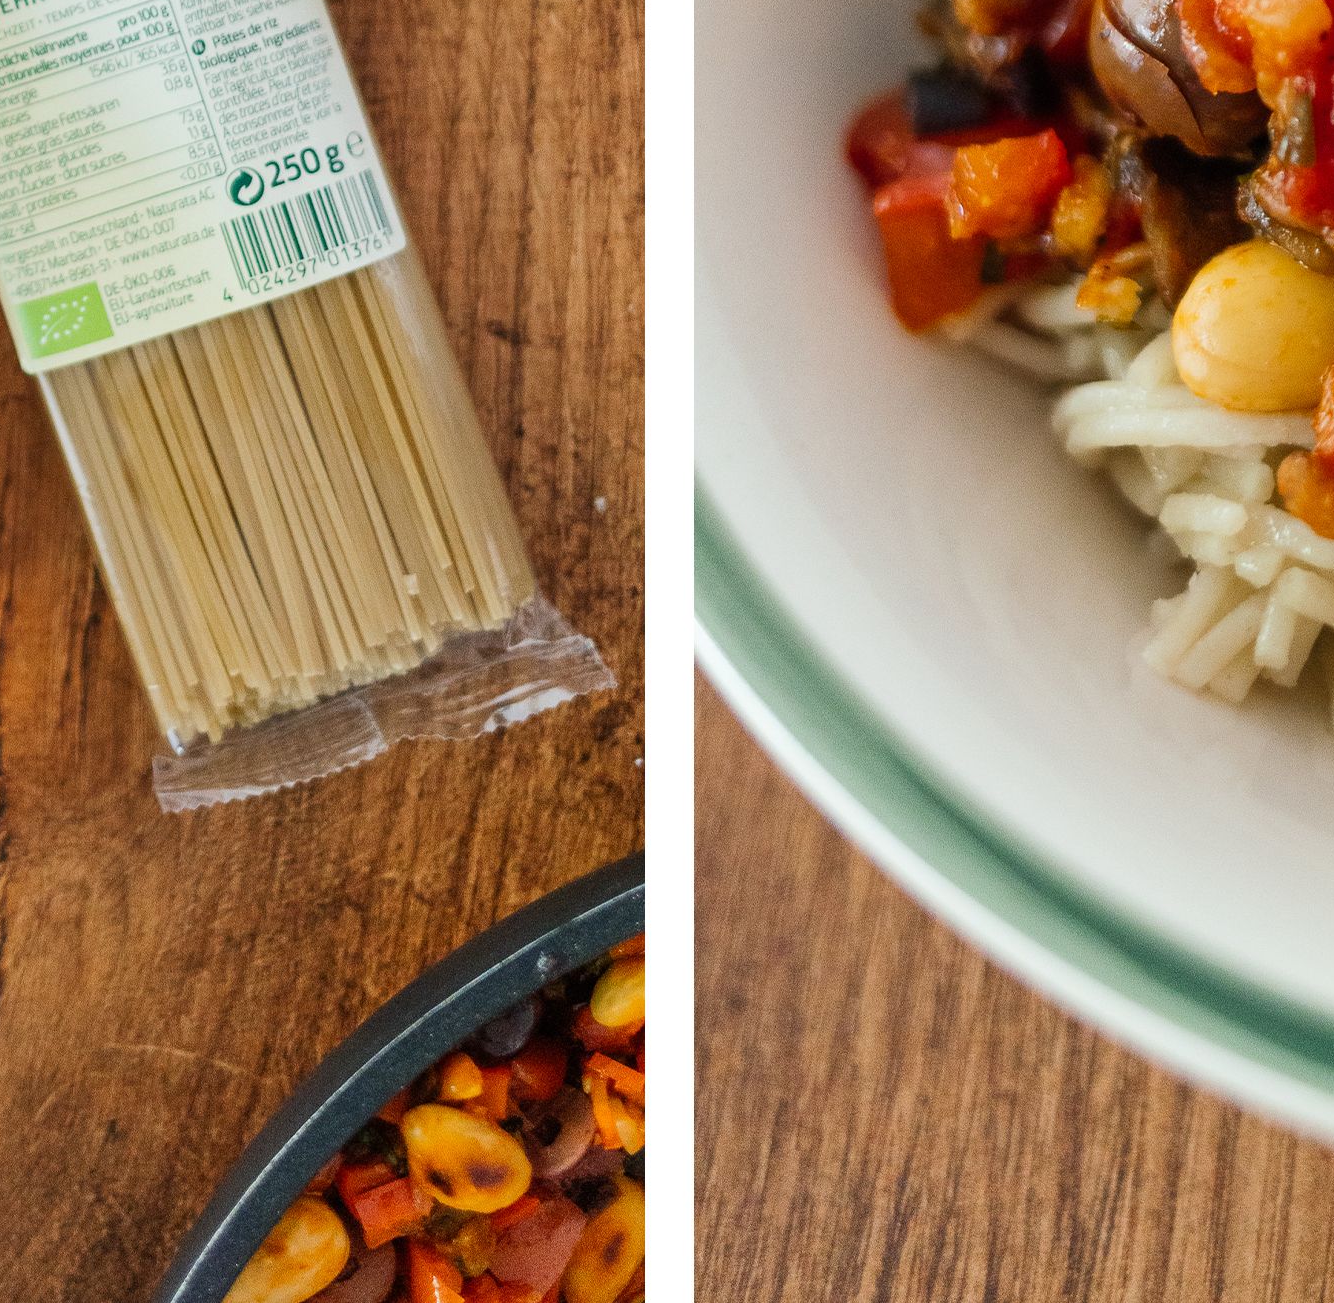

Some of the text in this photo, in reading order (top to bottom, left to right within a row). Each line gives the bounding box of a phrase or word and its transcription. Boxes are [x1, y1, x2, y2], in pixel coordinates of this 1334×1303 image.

[44, 1, 85, 24] TEMPS
[115, 14, 138, 33] pro
[136, 3, 160, 22] 100
[141, 19, 165, 38] 100
[211, 26, 246, 48] Pâtes
[245, 20, 263, 36] de
[263, 145, 324, 188] 250
[322, 142, 346, 175] g
[219, 229, 393, 304] 4 024297 013761
